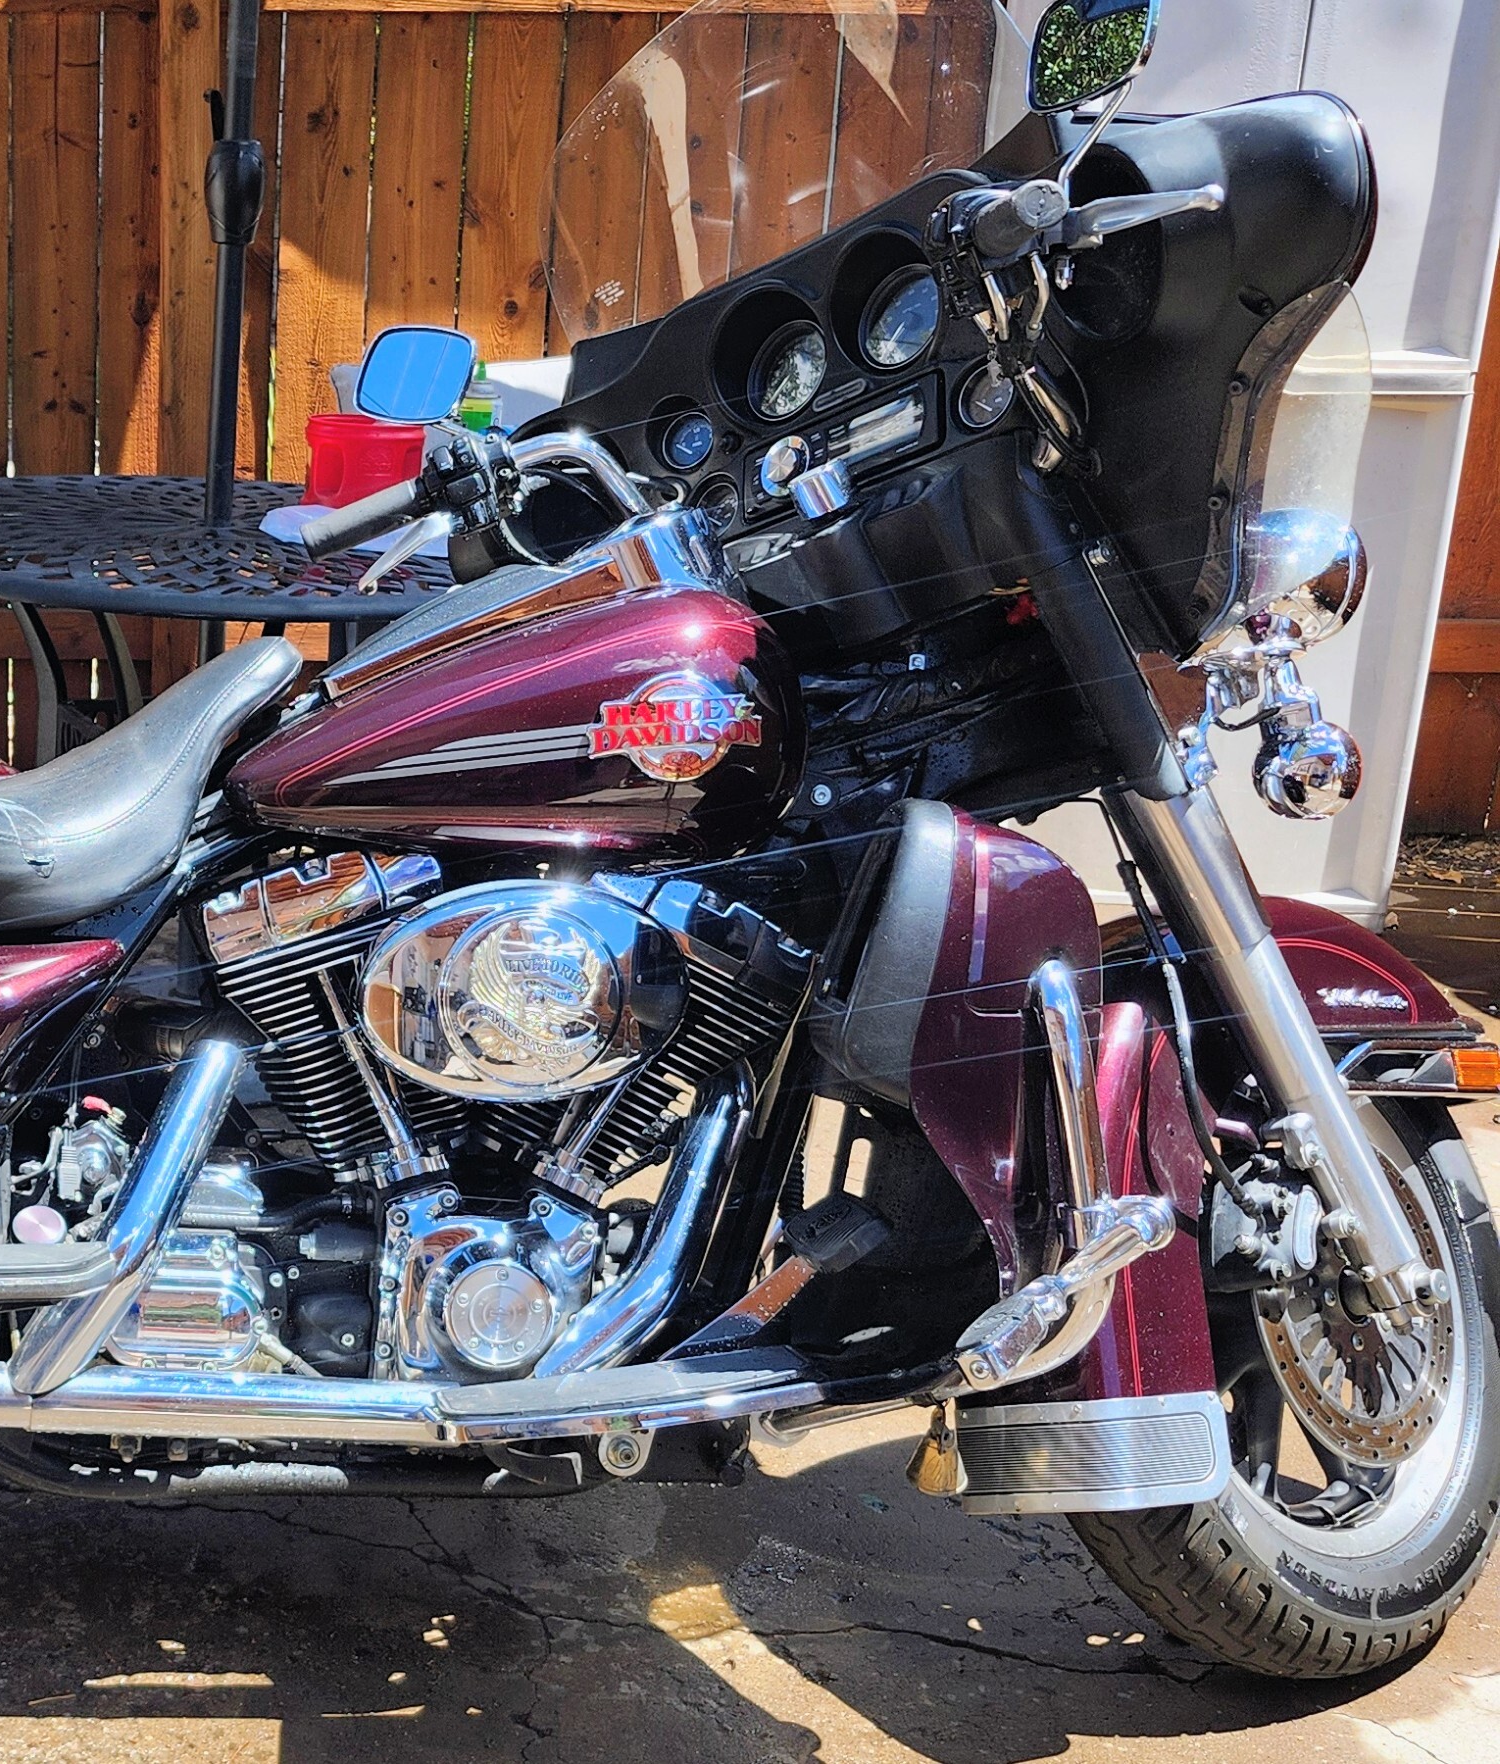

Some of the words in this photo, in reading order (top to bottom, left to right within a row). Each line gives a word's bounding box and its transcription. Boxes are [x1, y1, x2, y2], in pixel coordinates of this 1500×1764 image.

[605, 697, 743, 726] HARLEY
[592, 719, 760, 753] DAVIDSON
[507, 958, 541, 972] LIVE
